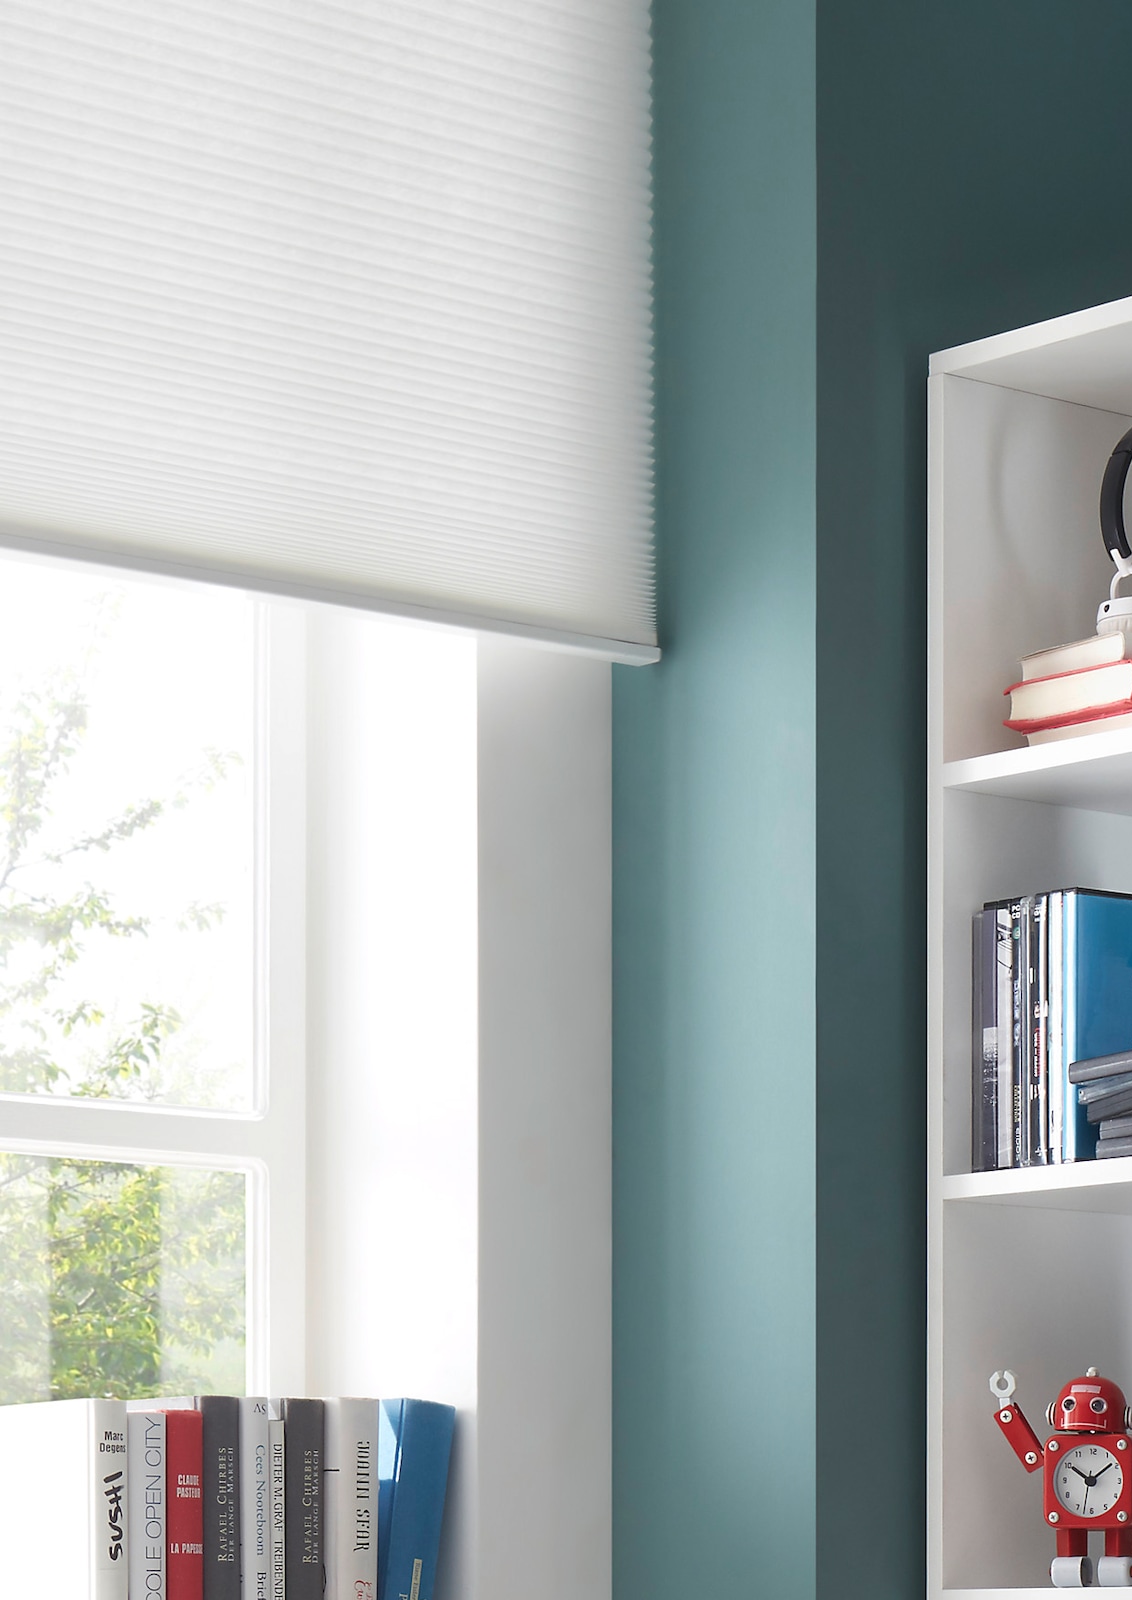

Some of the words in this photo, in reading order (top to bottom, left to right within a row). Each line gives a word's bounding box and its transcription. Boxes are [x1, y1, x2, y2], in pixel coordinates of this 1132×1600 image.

[99, 1443, 126, 1454] Degens
[104, 1431, 124, 1441] Marc
[145, 1416, 162, 1468] CITY
[255, 1444, 266, 1476] Cees
[216, 1446, 227, 1506] CHIRBES
[273, 1443, 283, 1483] DIETER
[302, 1450, 312, 1507] CHIRBES
[103, 1471, 125, 1561] SUSHI
[145, 1474, 162, 1539] OPEN
[255, 1480, 267, 1556] Nooteboom
[273, 1502, 283, 1532] GRAF
[170, 1543, 179, 1554] LA
[217, 1511, 228, 1562] RAFAEL
[302, 1513, 312, 1564] RAFAEL
